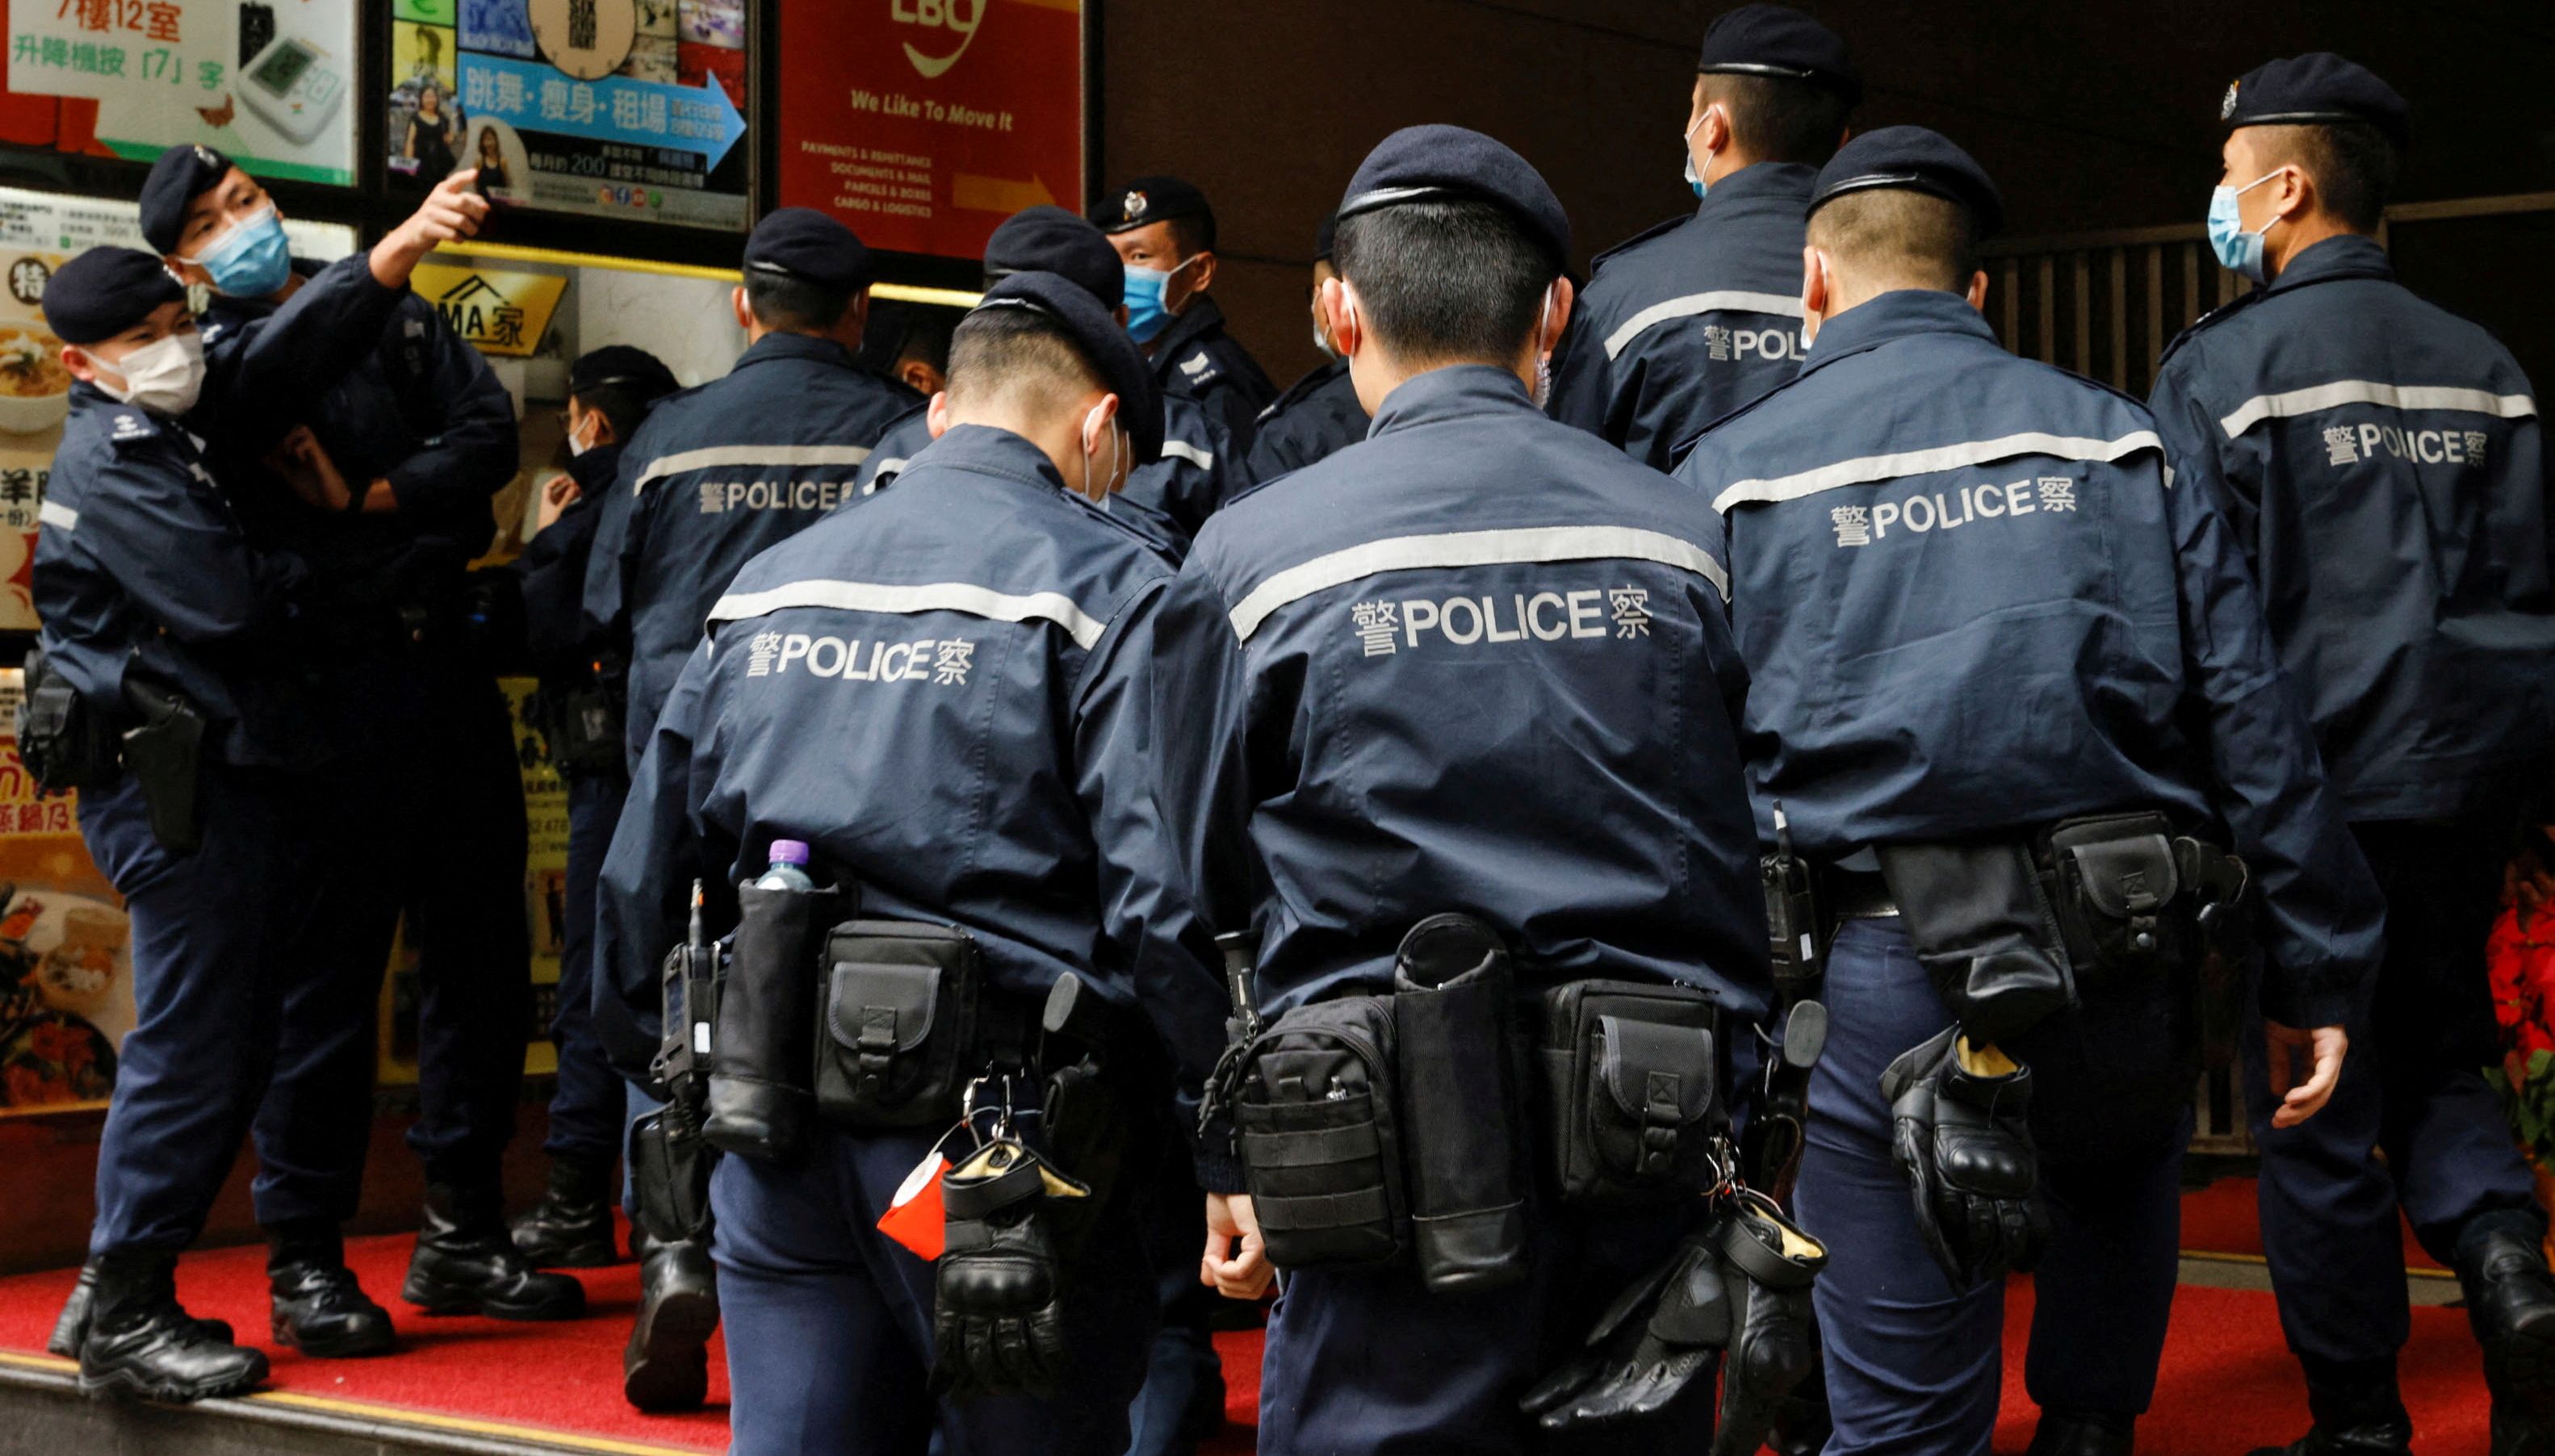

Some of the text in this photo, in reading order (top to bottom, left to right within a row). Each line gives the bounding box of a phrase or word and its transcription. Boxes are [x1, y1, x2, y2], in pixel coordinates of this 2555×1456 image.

[851, 90, 1013, 132] We Like To Move It
[801, 140, 858, 159] PAYMENTS
[861, 148, 868, 161] &
[571, 153, 606, 176] 200
[831, 161, 932, 185] DOCUMENTS & MAIL
[844, 180, 932, 202] PARCELS & BOXES
[834, 195, 932, 218] CARGO & LOGISTICS
[14, 262, 45, 299] 特
